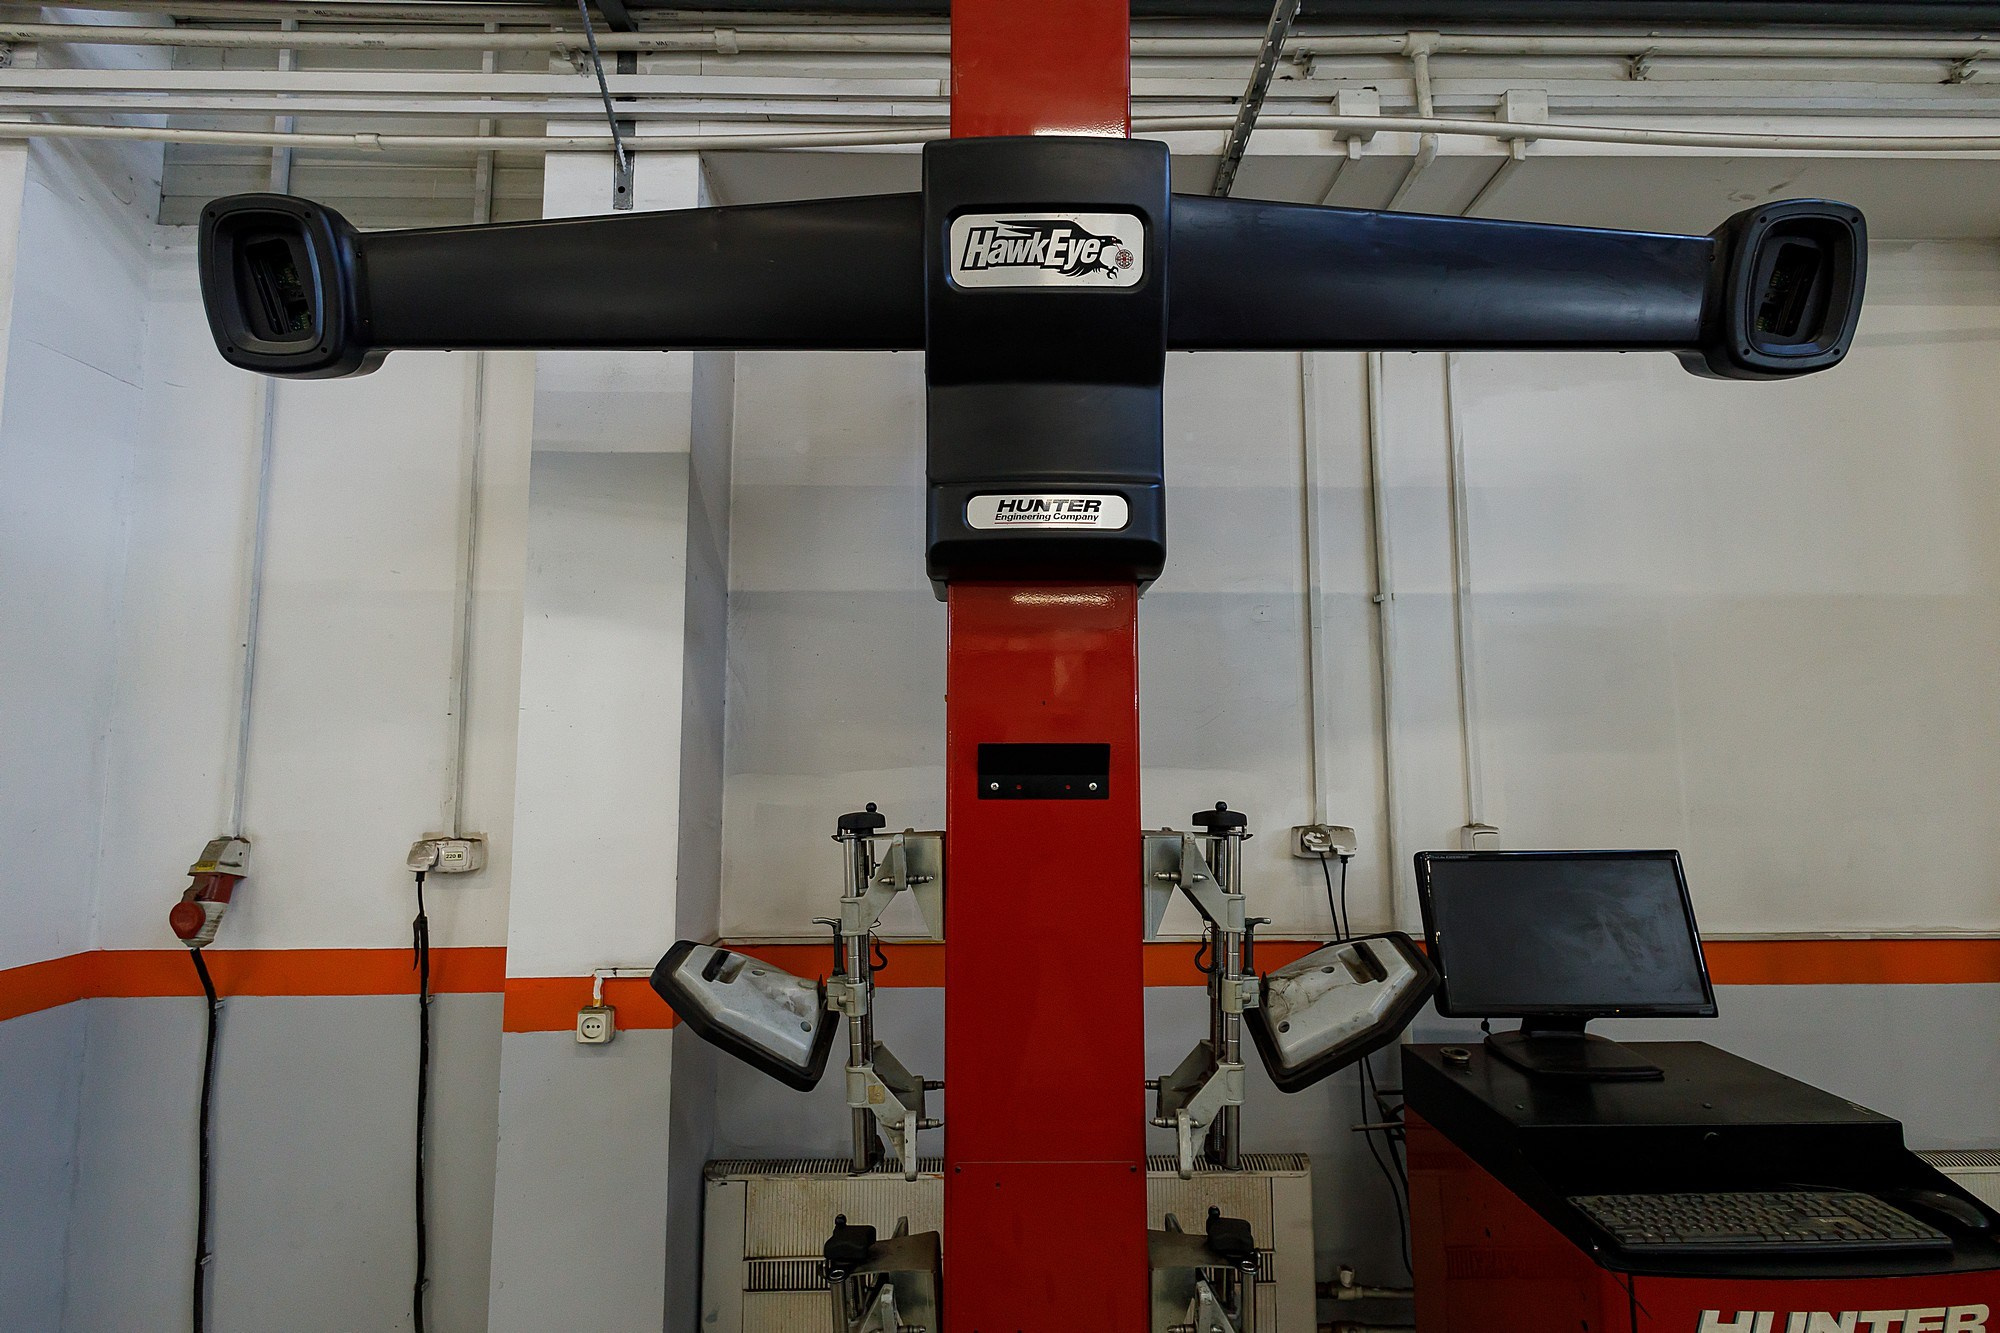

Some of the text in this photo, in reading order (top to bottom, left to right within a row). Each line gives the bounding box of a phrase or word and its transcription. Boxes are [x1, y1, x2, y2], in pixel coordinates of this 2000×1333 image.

[961, 228, 1101, 270] HawkEye
[997, 499, 1102, 513] HUNTER
[995, 512, 1099, 522] Engineering Company
